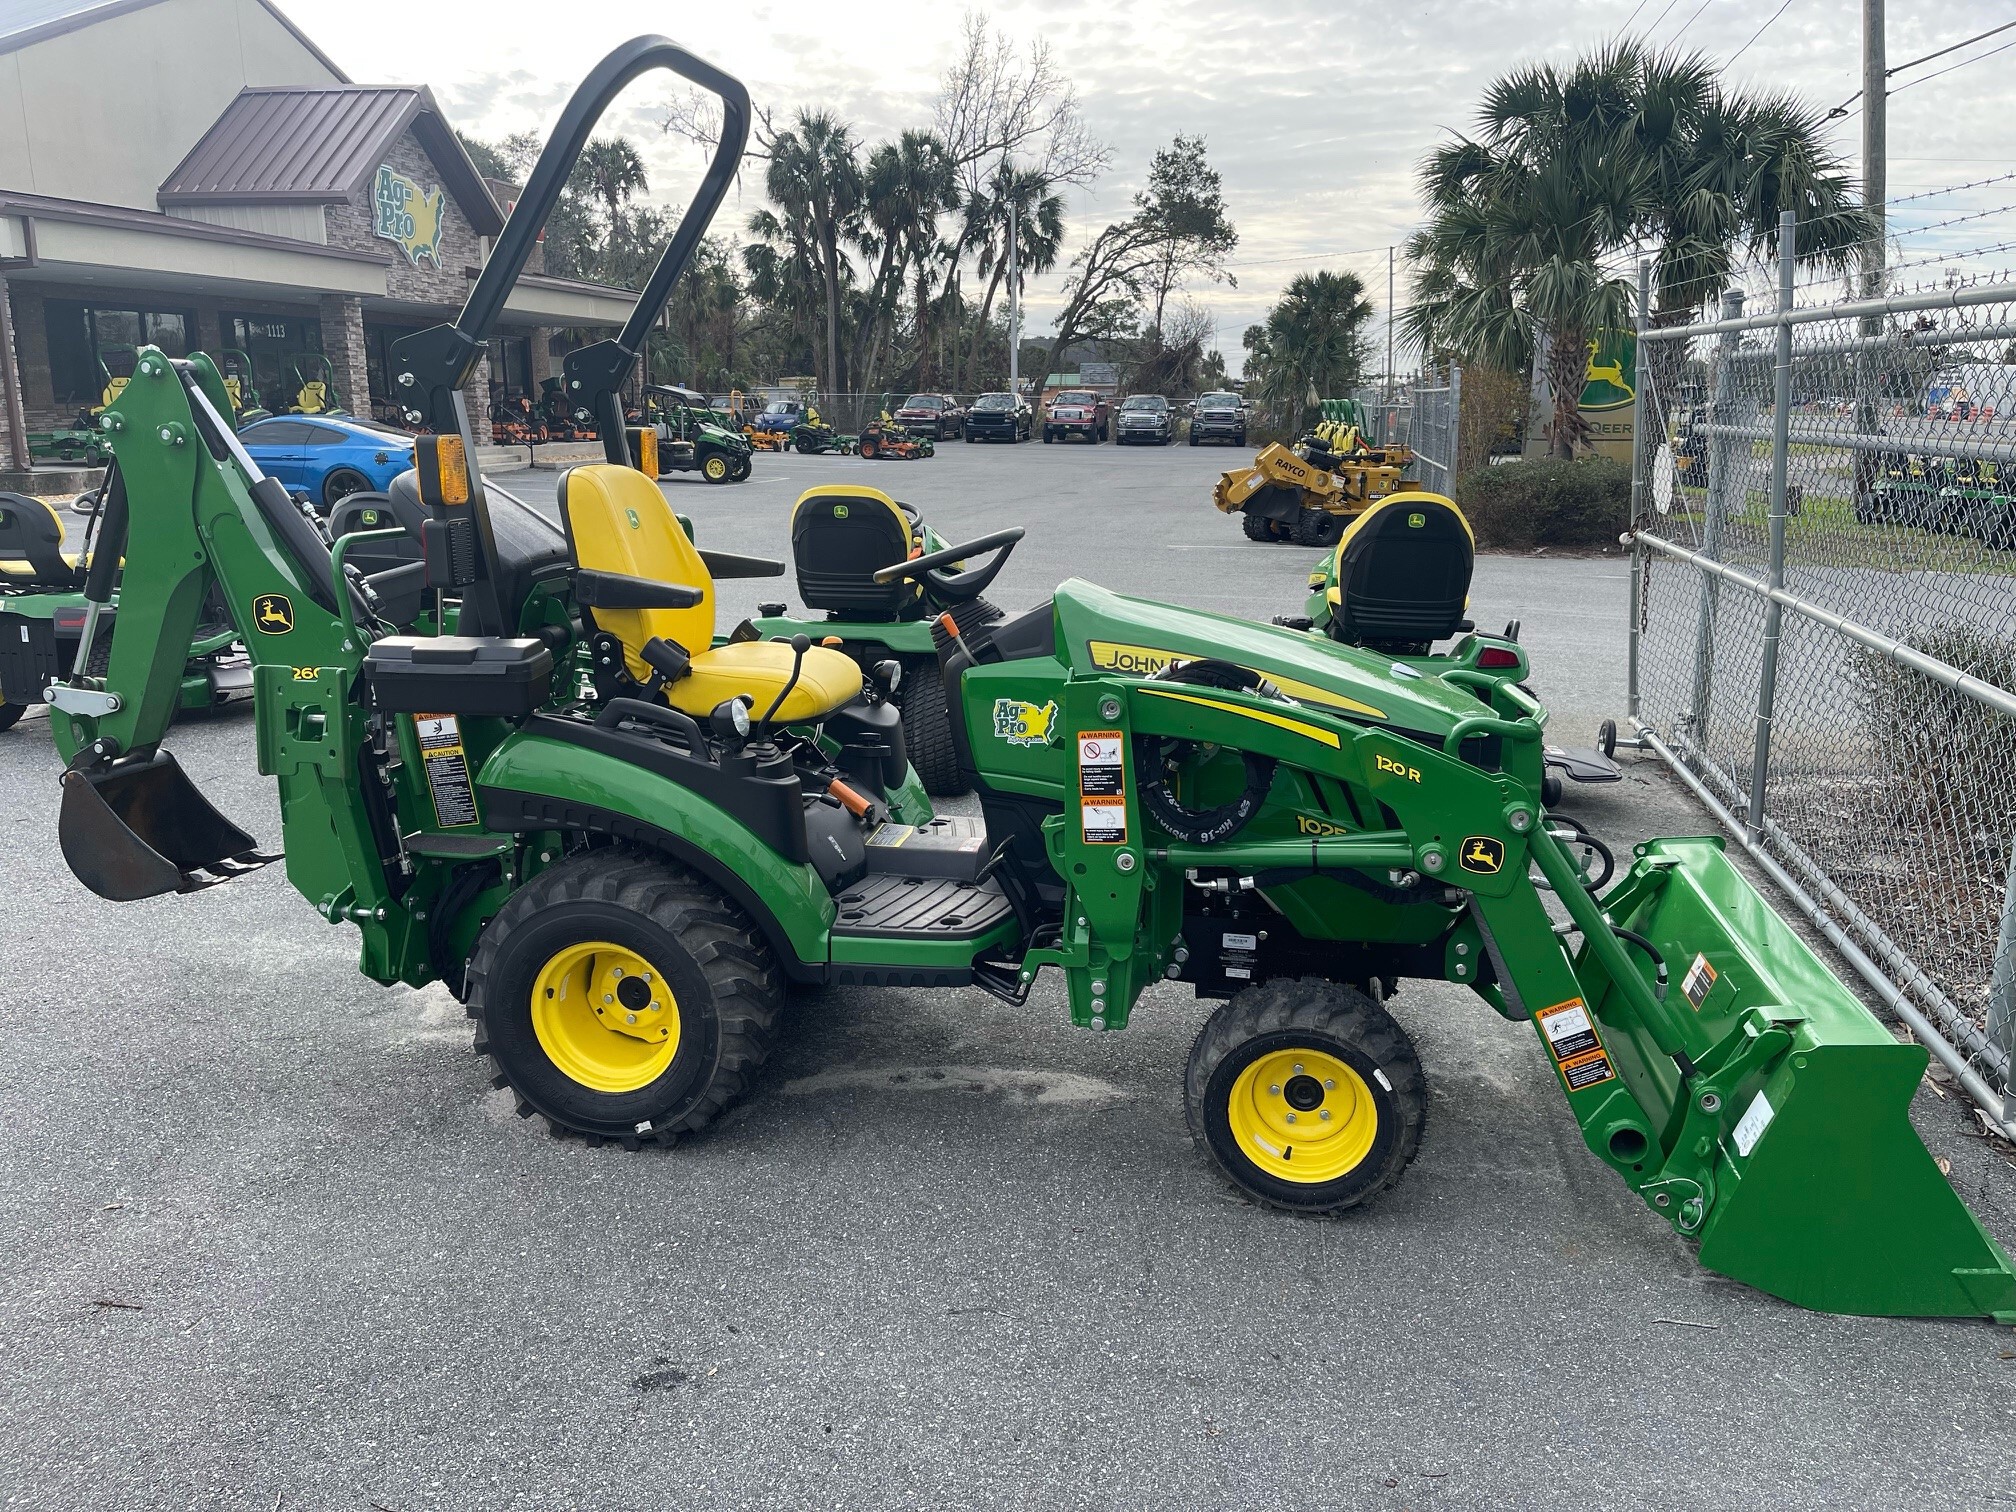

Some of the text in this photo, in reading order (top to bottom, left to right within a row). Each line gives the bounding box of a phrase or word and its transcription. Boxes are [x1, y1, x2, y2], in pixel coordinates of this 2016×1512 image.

[379, 169, 413, 212] Ag-
[379, 201, 416, 239] Pro
[266, 324, 286, 338] 1113
[1274, 458, 1306, 478] RAYCO
[1106, 650, 1165, 673] JOHN
[997, 701, 1026, 721] Ag-
[997, 718, 1027, 735] Pro
[1087, 731, 1121, 739] WARNING
[432, 749, 459, 758] CAUTION
[1089, 798, 1123, 806] WARNING
[1548, 1001, 1578, 1015] WARNING
[1572, 1053, 1602, 1067] WARNING
